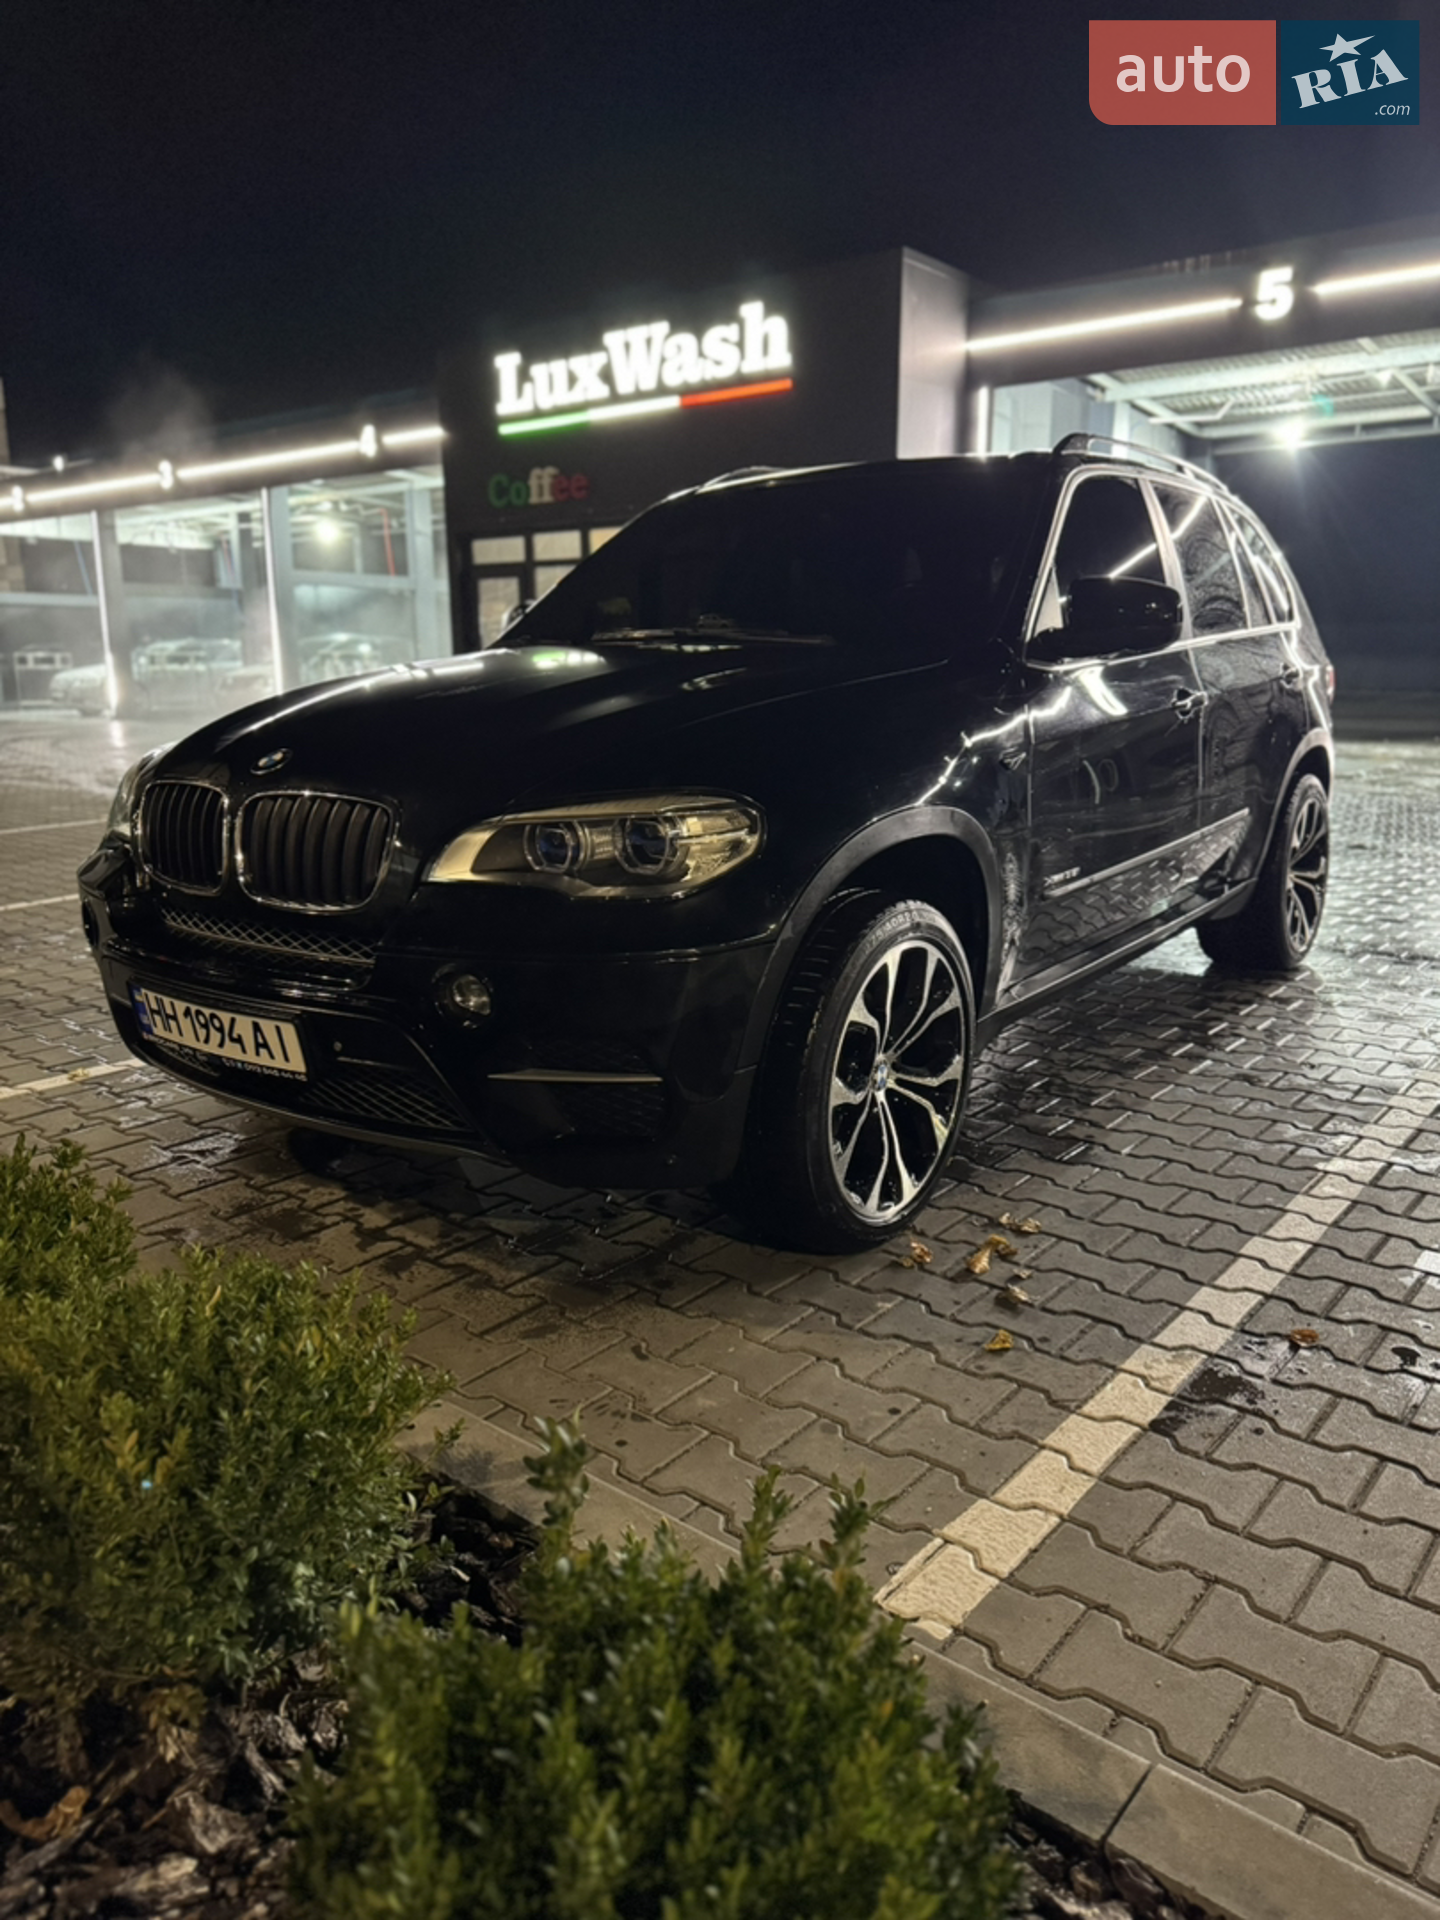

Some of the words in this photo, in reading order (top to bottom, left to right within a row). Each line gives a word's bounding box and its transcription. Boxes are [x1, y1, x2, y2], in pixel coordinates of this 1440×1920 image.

[1255, 267, 1294, 320] 5
[494, 300, 793, 416] LuxWash
[360, 424, 376, 458] 4
[488, 466, 589, 507] Coffee
[144, 992, 184, 1037] HH
[182, 1005, 247, 1054] 1994
[251, 1020, 291, 1063] AI
